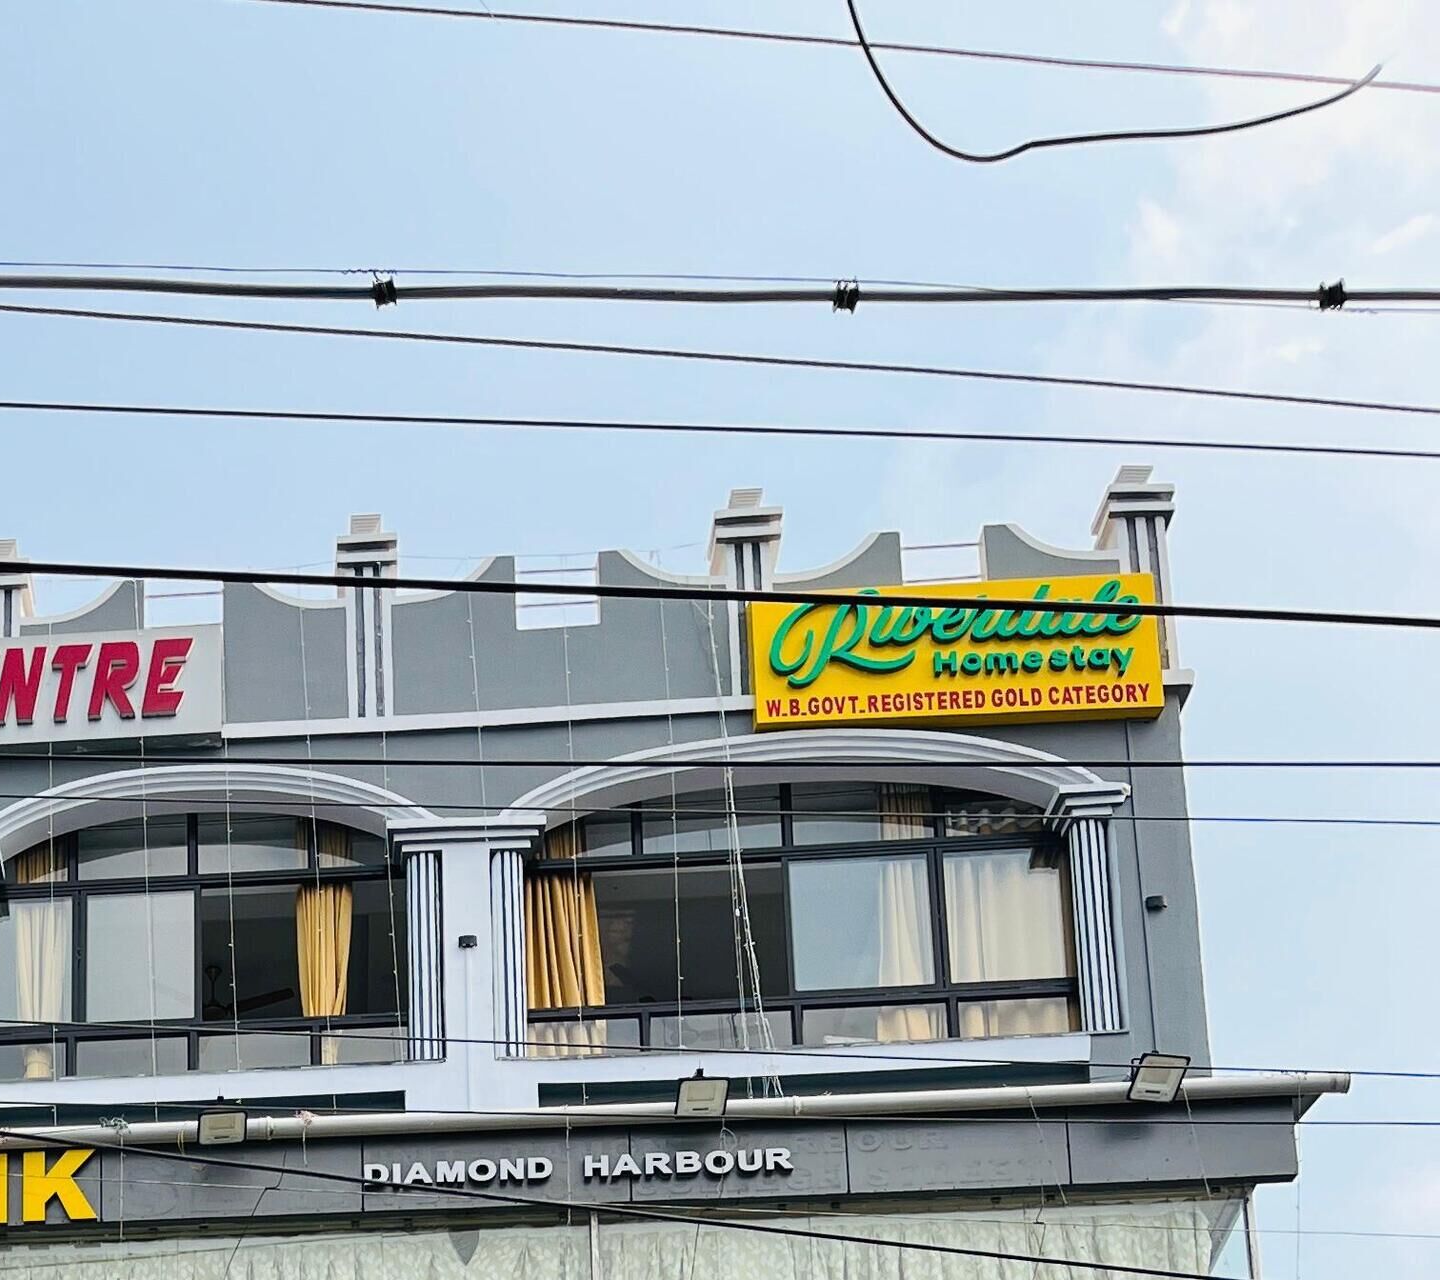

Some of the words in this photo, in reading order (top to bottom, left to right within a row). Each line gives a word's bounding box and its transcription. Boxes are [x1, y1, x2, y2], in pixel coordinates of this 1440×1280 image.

[992, 686, 1041, 709] GOLD
[1048, 683, 1151, 705] CATEGORY
[363, 1155, 554, 1186] DIAMOND
[583, 1145, 794, 1179] HARBOUR
